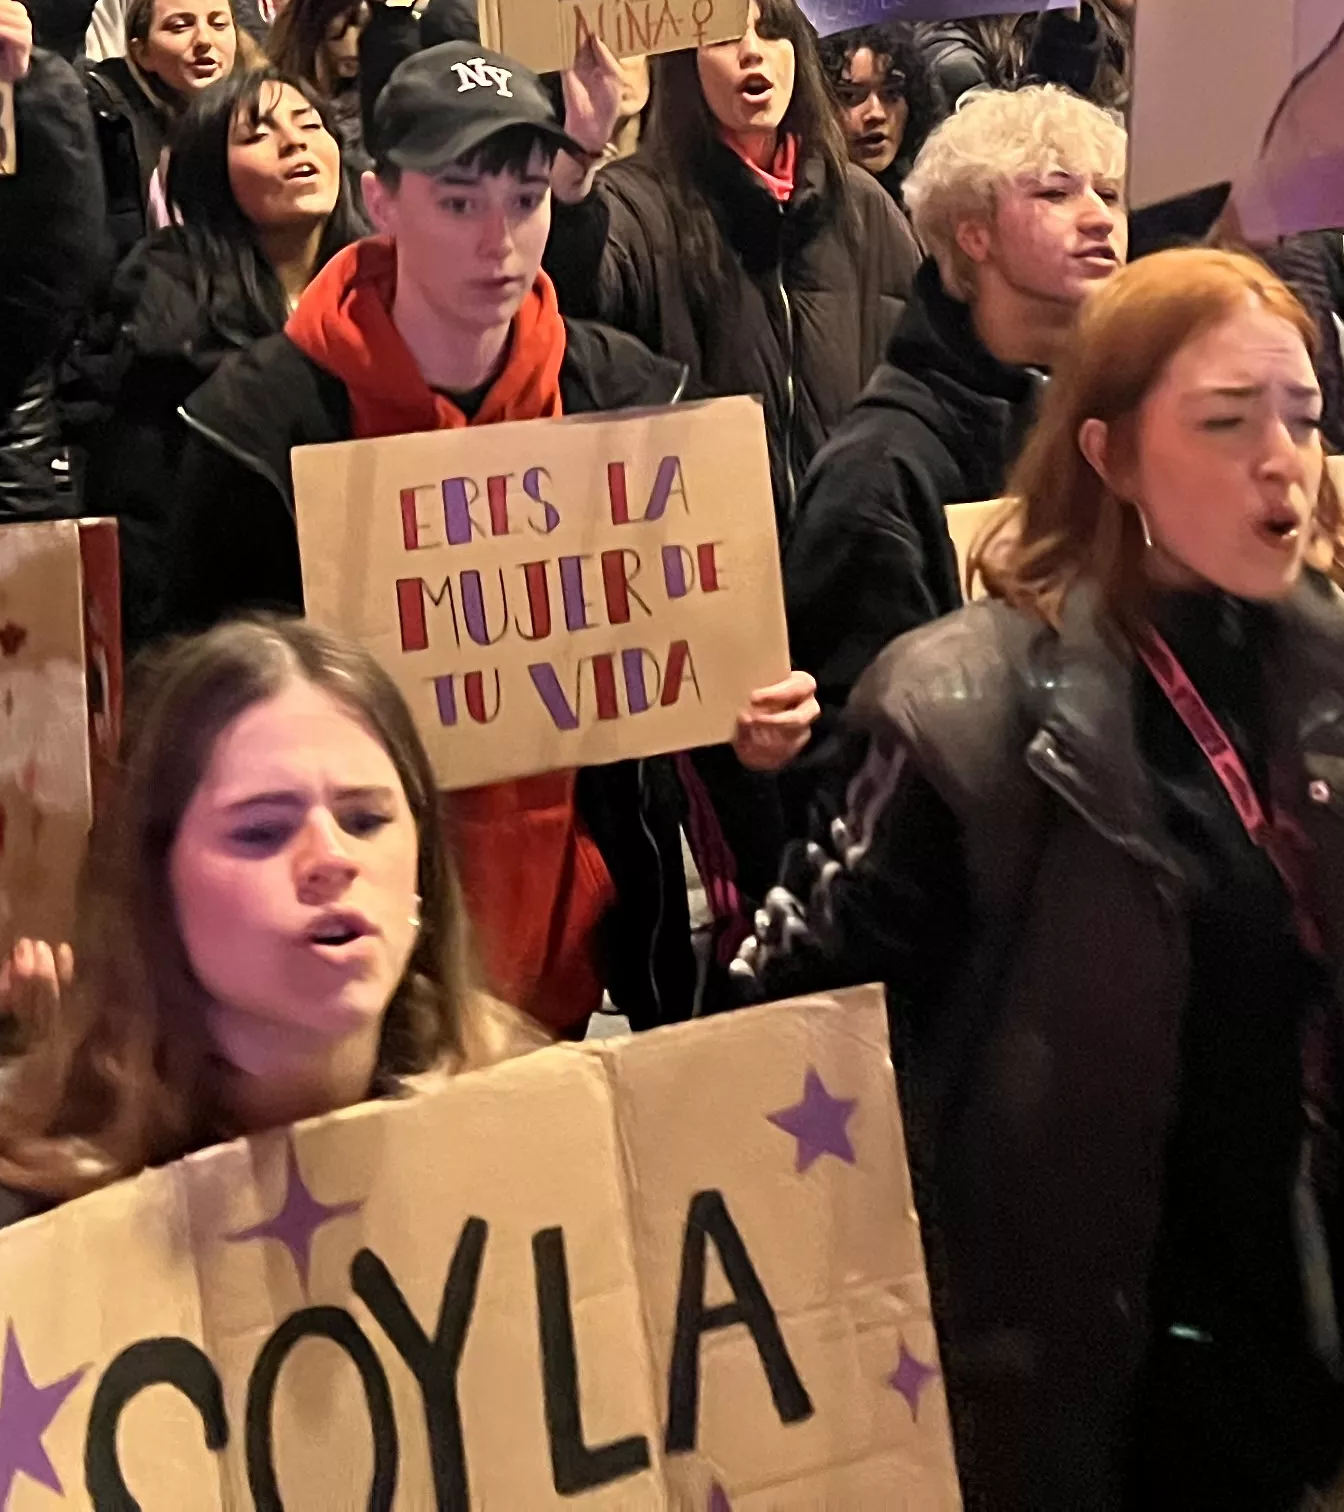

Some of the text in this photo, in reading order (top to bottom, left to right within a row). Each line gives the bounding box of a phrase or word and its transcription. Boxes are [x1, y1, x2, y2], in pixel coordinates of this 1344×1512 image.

[450, 57, 514, 99] NY
[398, 455, 692, 552] ERES LA
[396, 540, 726, 653] MUJER DE
[426, 639, 703, 732] TU VIDA
